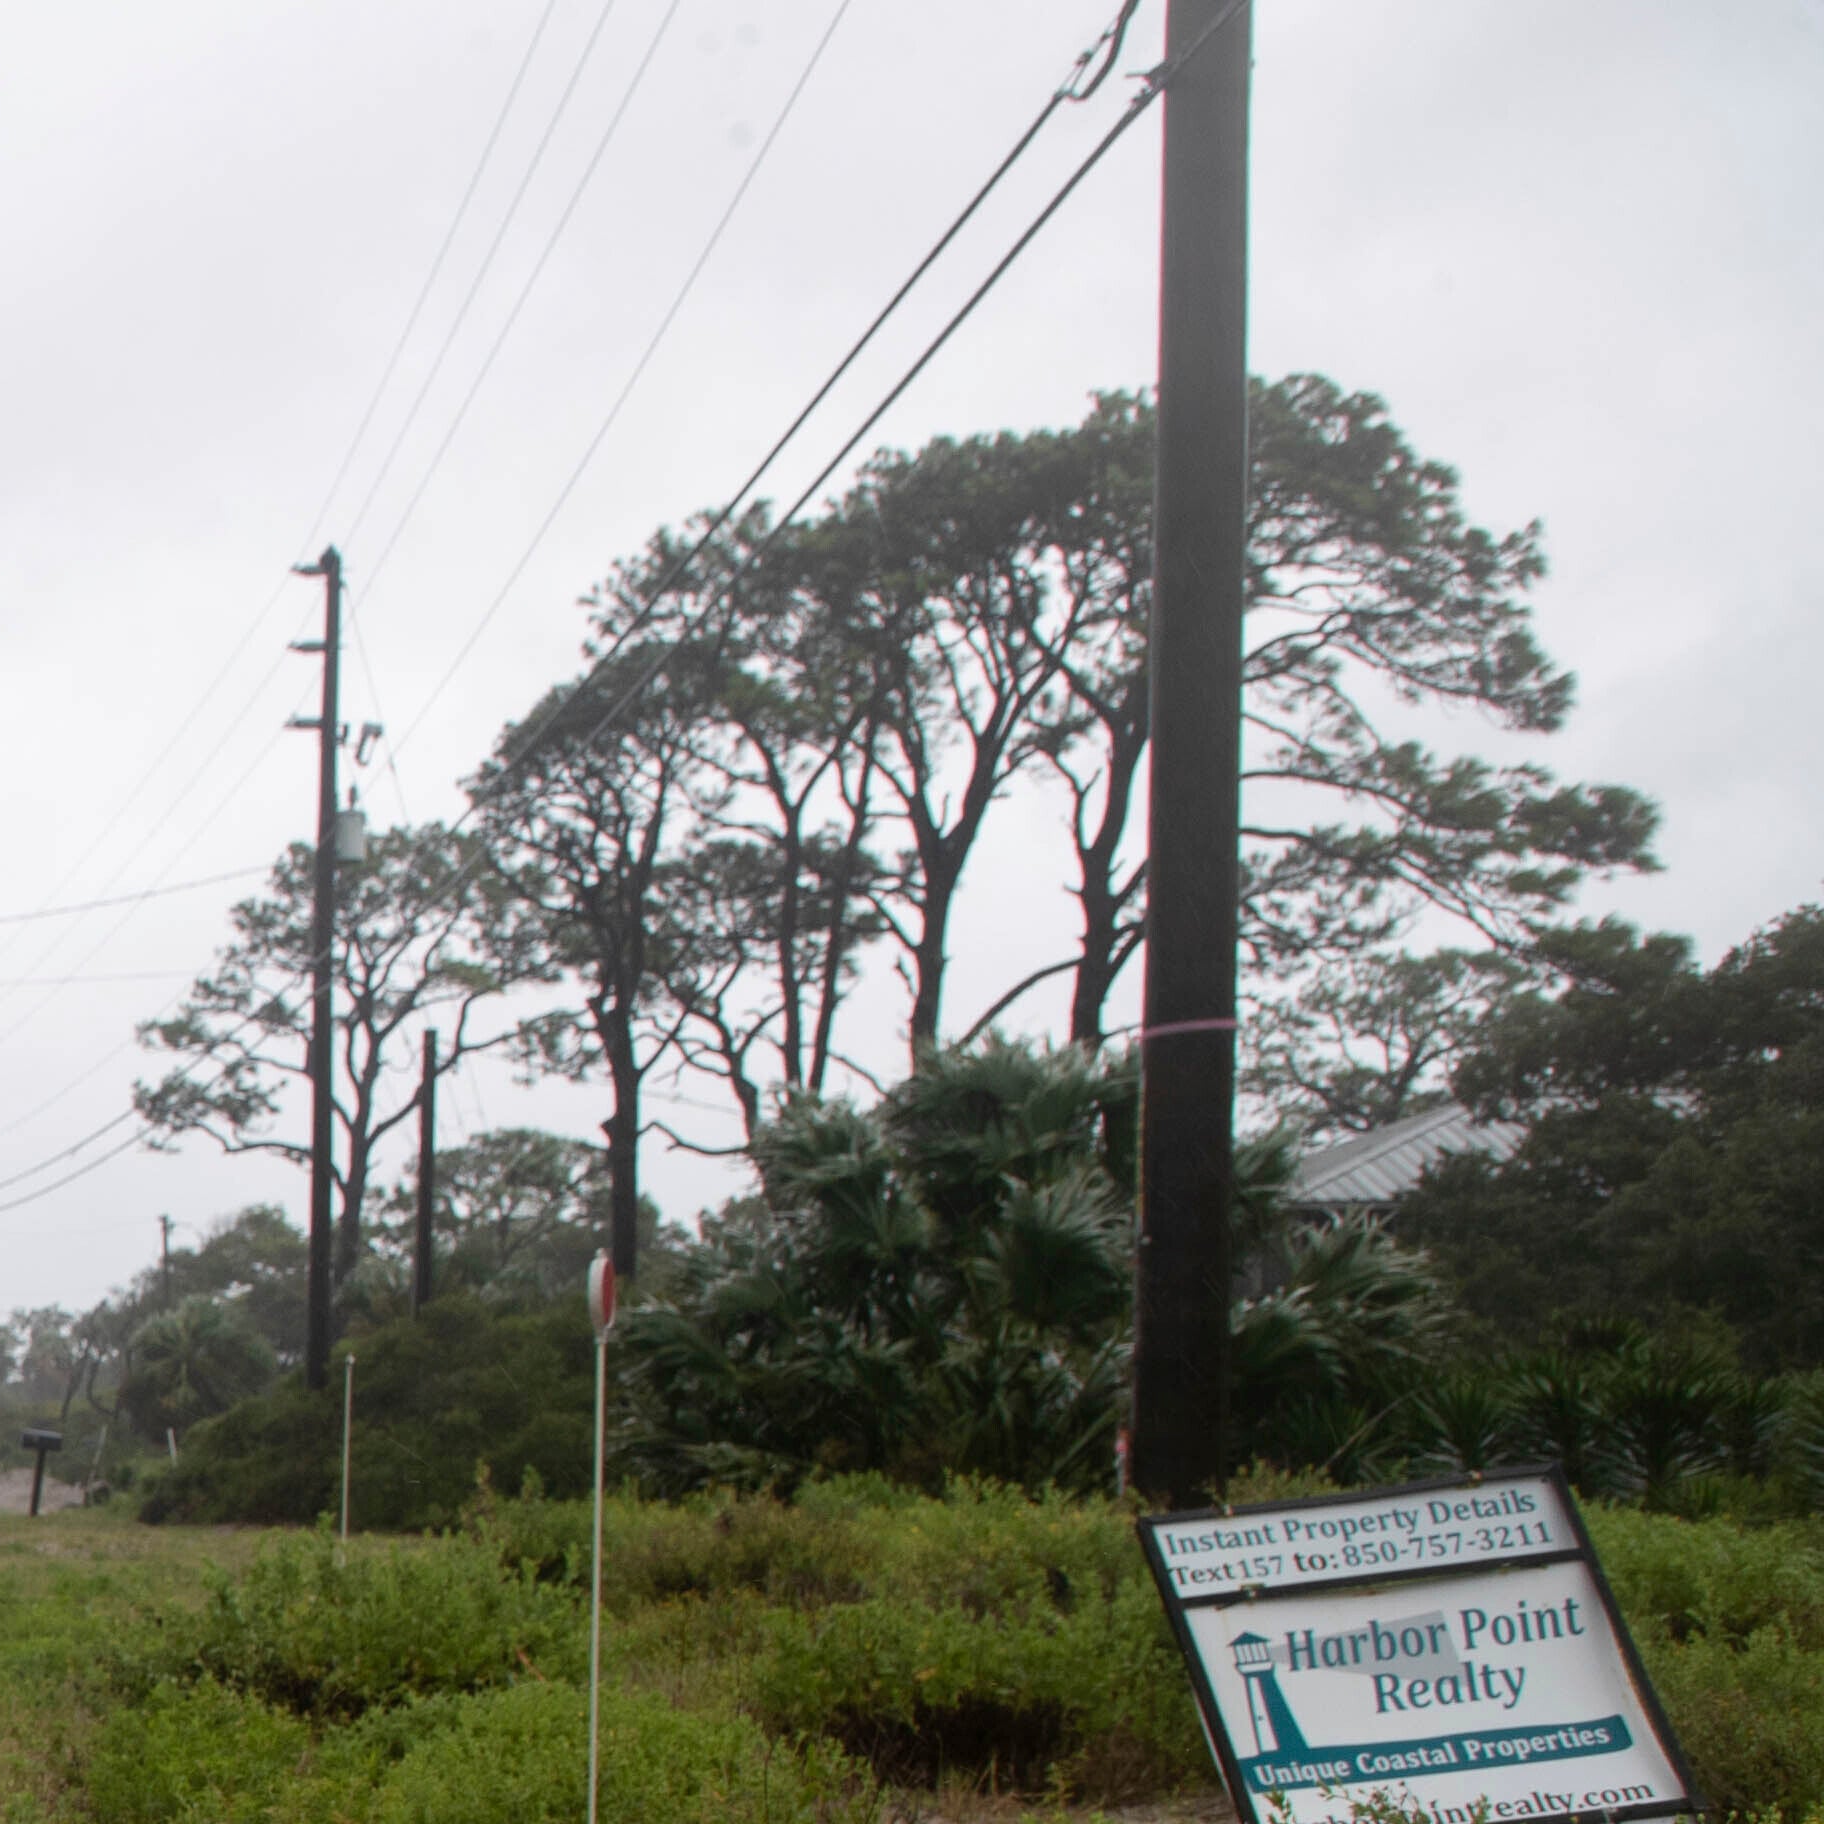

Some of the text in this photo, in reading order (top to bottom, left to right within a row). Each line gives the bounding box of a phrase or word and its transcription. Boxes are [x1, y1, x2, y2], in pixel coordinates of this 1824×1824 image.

[1164, 1489, 1537, 1556] Instant Property Details
[1284, 1598, 1585, 1672] Harbor Point
[1371, 1661, 1525, 1714] Realty
[1254, 1725, 1611, 1787] Unique Coastal Properties
